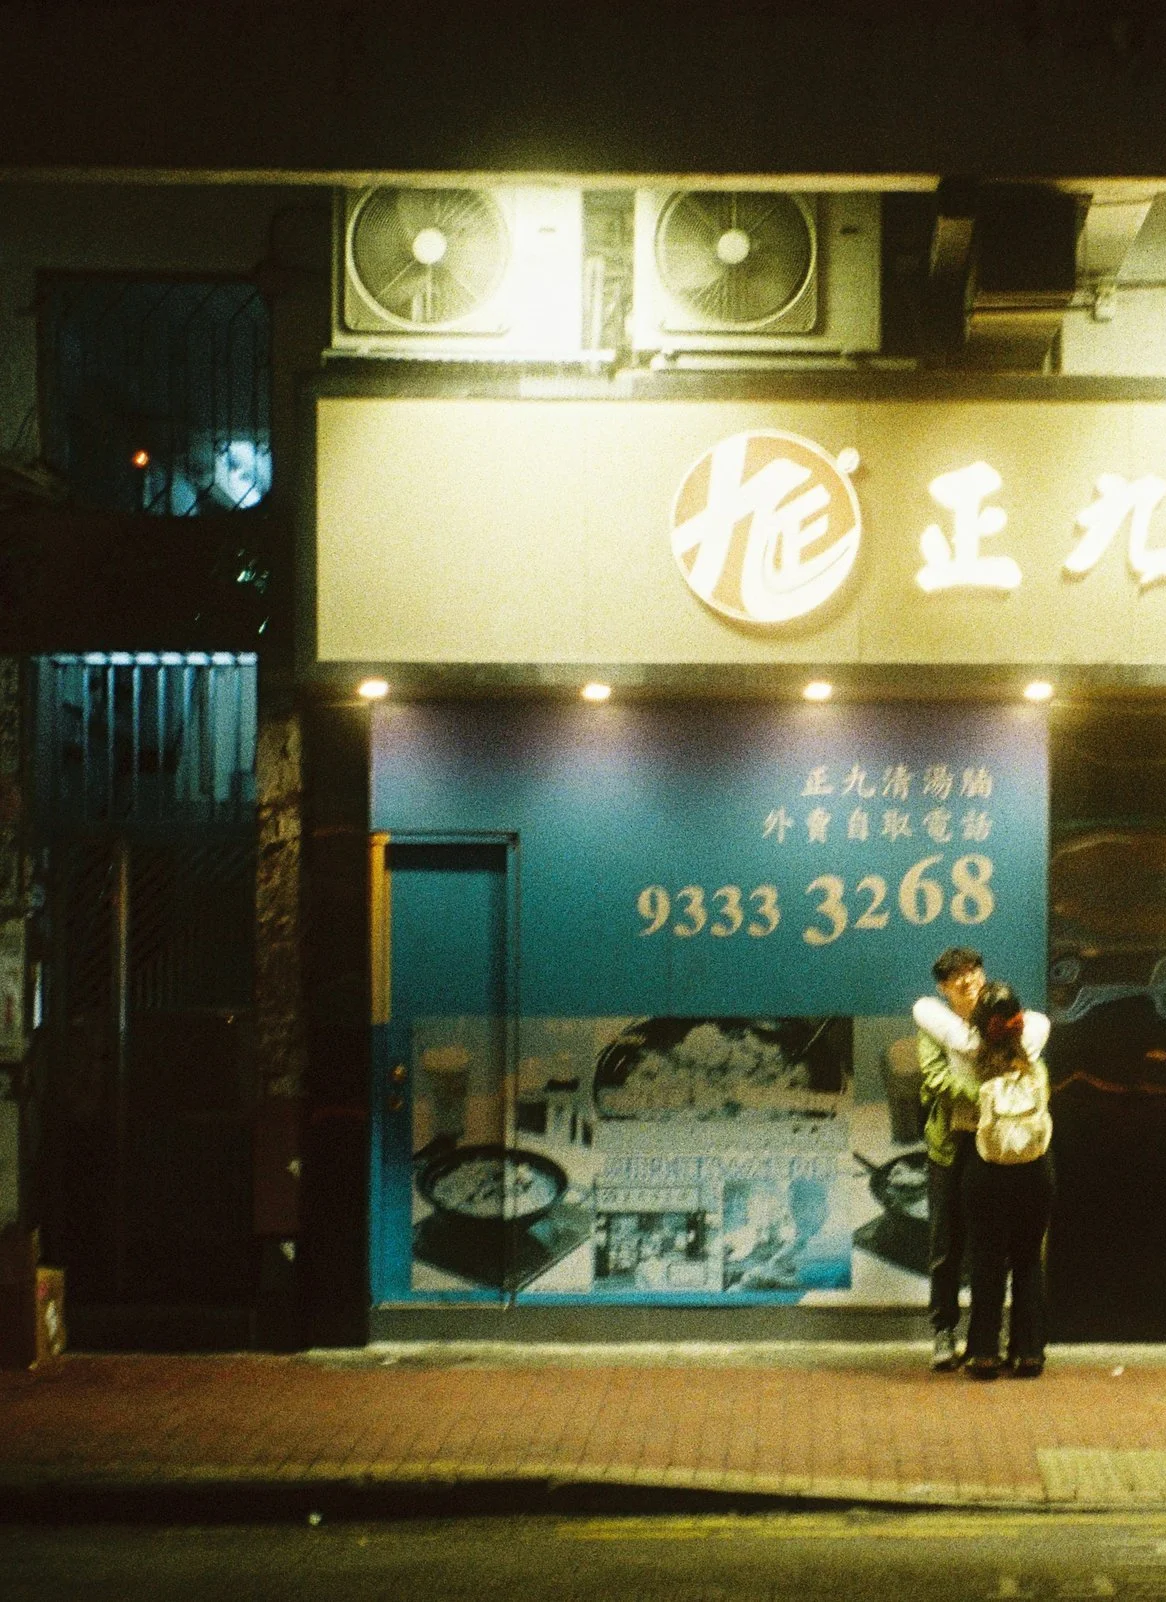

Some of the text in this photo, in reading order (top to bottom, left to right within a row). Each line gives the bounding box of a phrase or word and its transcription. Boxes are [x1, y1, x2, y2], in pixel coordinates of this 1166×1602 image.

[800, 763, 994, 801] 正九清湯腩
[761, 804, 993, 844] 外賣自取電話
[636, 853, 996, 947] 9333 3268
